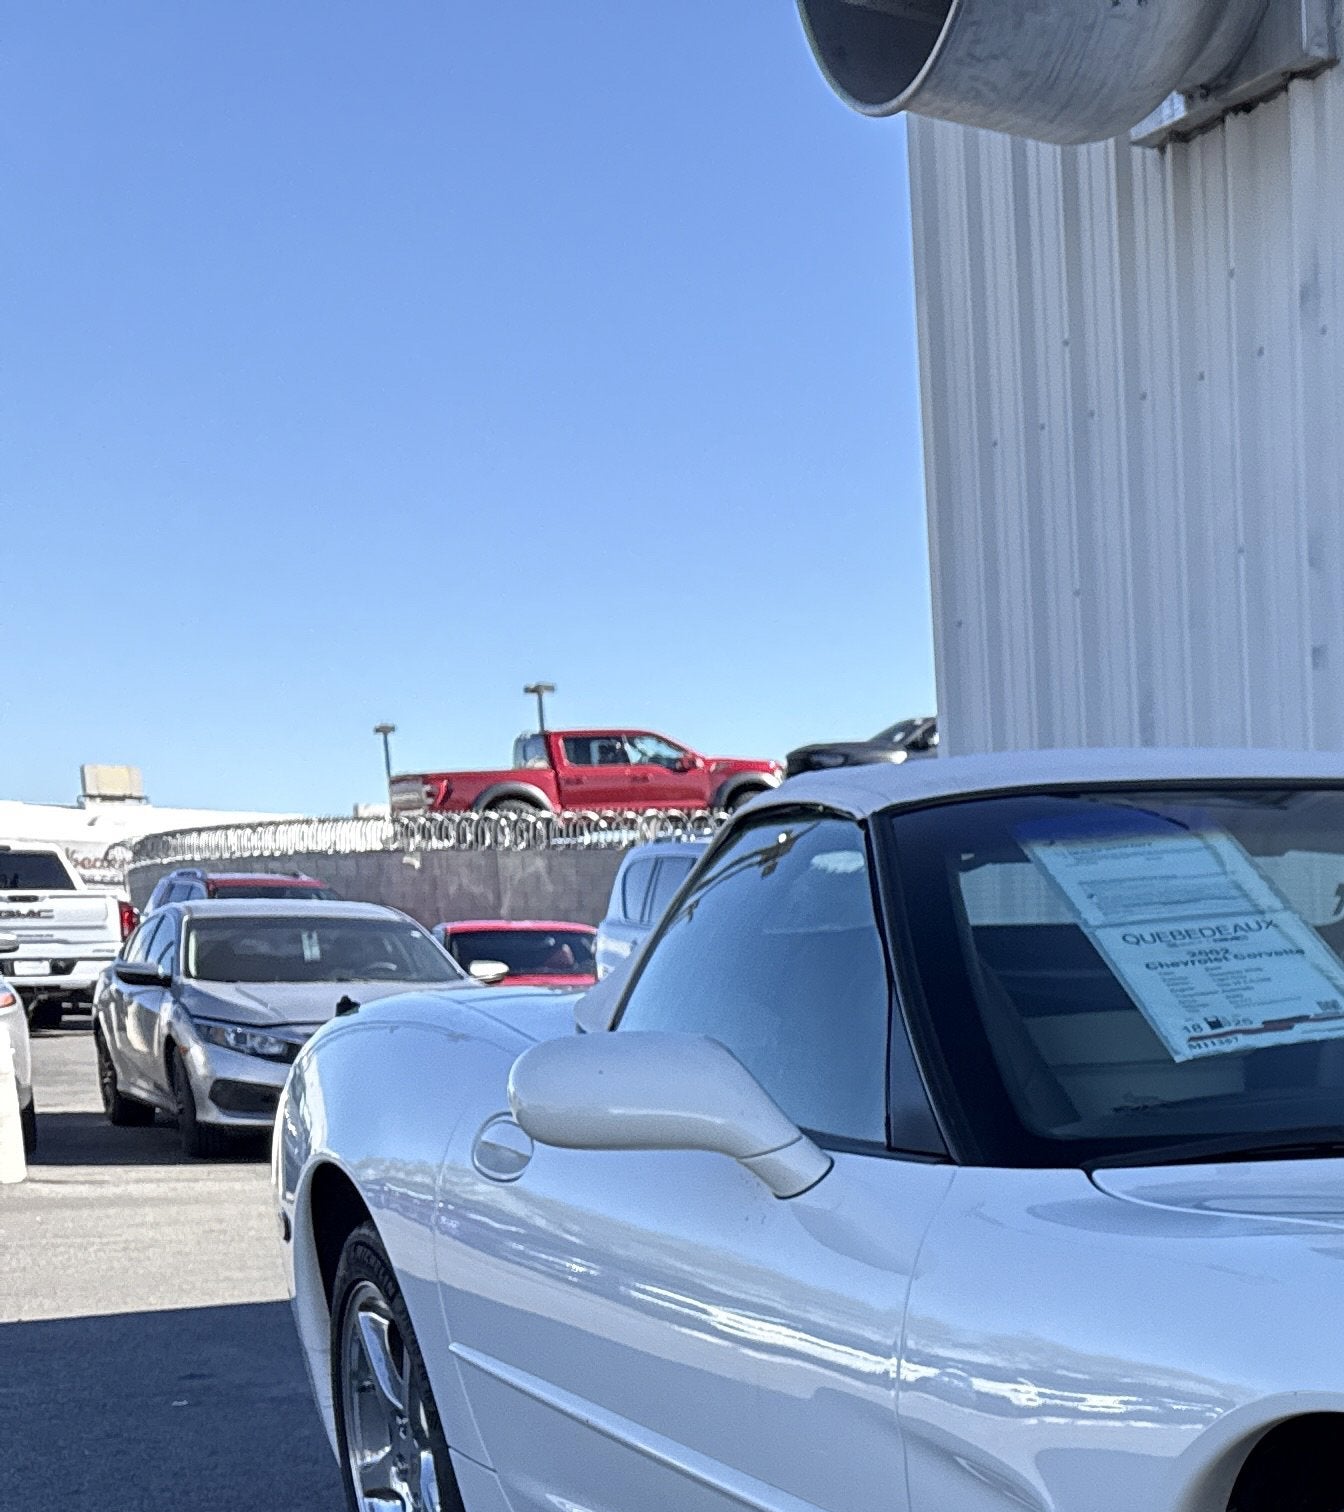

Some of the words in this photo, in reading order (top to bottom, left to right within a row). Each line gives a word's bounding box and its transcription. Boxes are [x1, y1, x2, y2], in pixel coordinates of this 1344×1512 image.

[1121, 919, 1279, 946] QUEBEDEAUX
[1144, 953, 1229, 970] Chevrolet
[1233, 949, 1306, 961] Corvette
[1187, 949, 1230, 958] 2002
